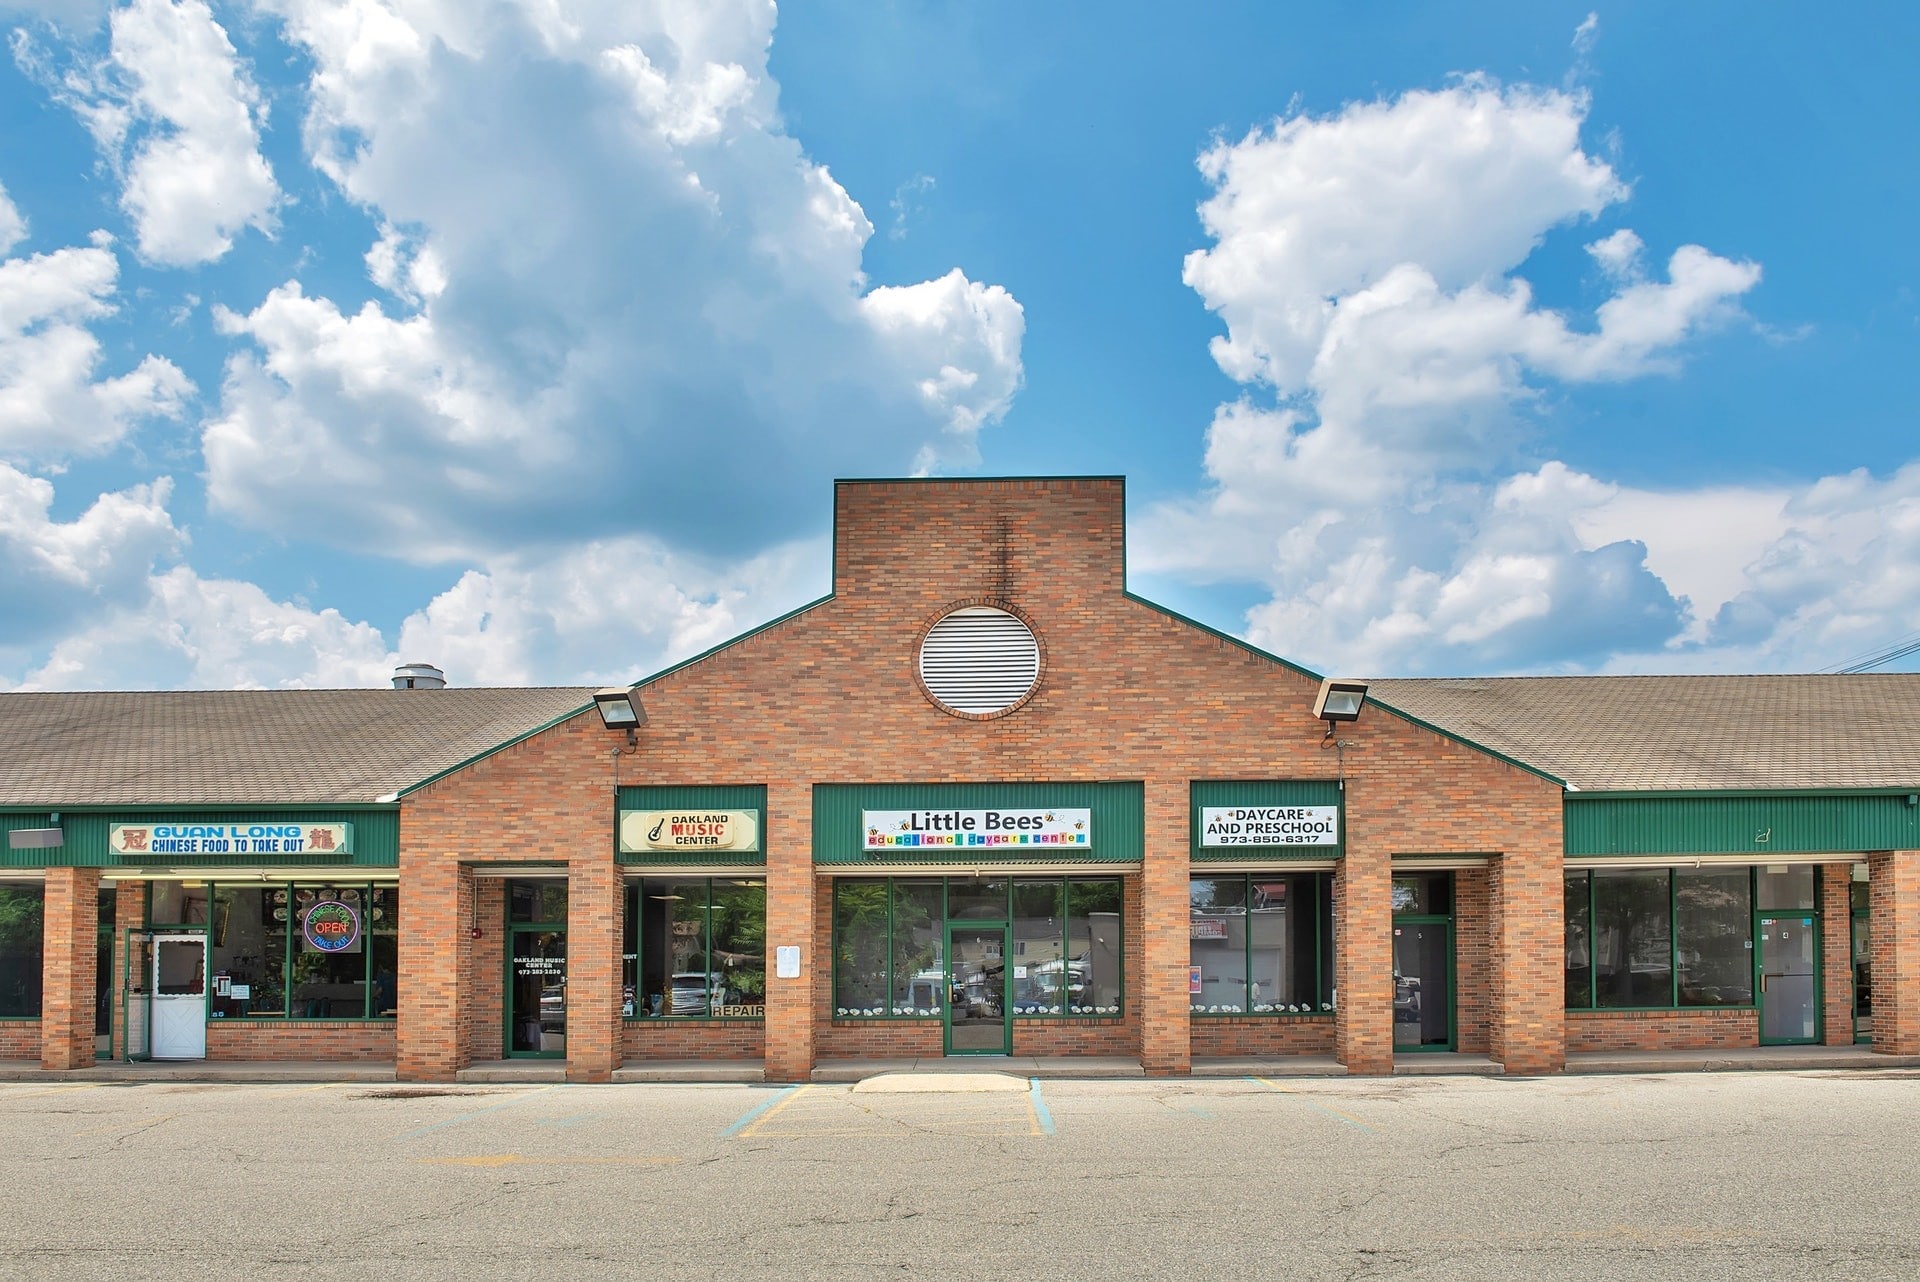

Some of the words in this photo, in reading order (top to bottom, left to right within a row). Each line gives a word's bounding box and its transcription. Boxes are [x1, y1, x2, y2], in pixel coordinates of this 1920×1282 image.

[672, 815, 728, 823] OAKLAND
[1236, 809, 1305, 820] DAYCARE
[911, 812, 976, 830] Little
[985, 812, 1043, 830] Bees
[154, 826, 223, 838] GUAN
[231, 826, 302, 837] LONG
[671, 824, 724, 836] MUSIC
[1207, 823, 1241, 834] AND
[1246, 822, 1333, 833] PRESCHOOL
[121, 829, 148, 850] 冠
[308, 828, 335, 850] 龍
[675, 836, 718, 845] CENTER
[868, 834, 963, 846] educational
[968, 834, 1028, 846] daycare
[1034, 832, 1085, 844] center
[152, 839, 197, 852] CHINESE
[201, 839, 229, 852] FOOD
[235, 839, 247, 852] TO
[252, 839, 279, 852] TAKE
[284, 839, 304, 852] OUT
[315, 922, 347, 934] OPEN
[314, 936, 332, 949] TAKE
[333, 935, 349, 948] OUT
[712, 1005, 765, 1016] REPAIR
